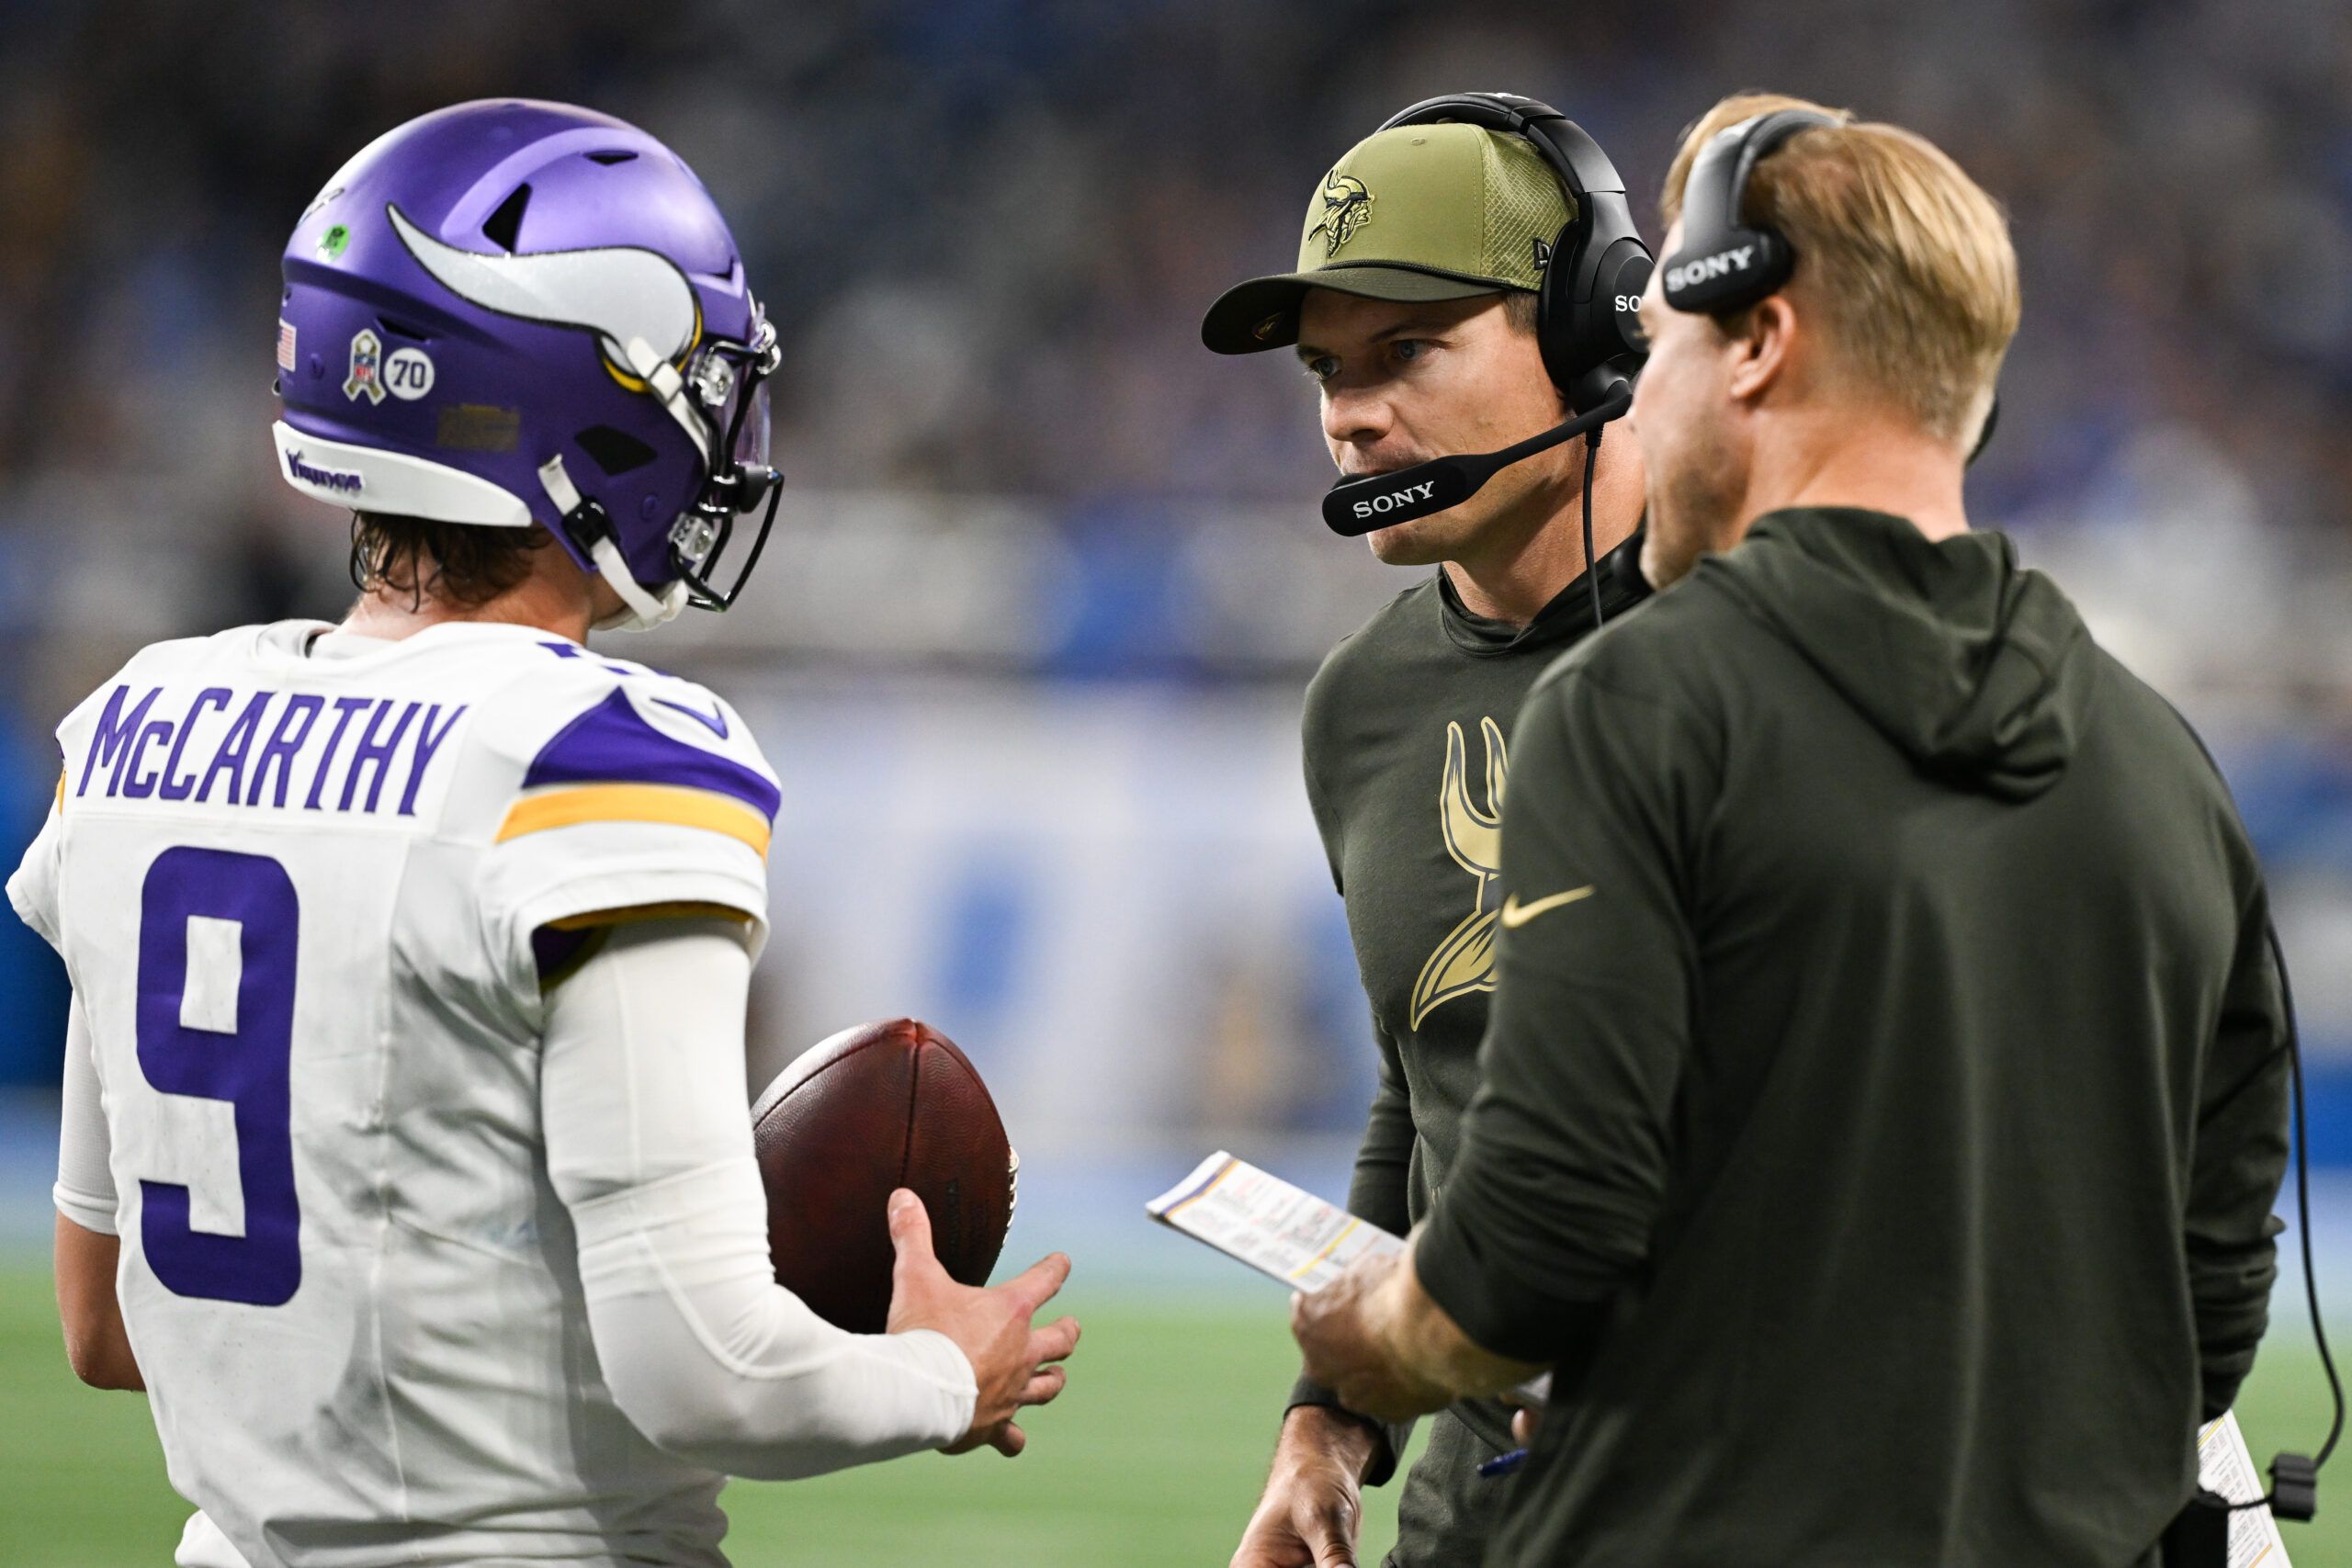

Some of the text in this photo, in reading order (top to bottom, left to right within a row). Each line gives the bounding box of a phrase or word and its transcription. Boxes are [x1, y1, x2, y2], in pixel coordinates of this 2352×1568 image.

[1665, 244, 1753, 293] SONY
[1614, 294, 1642, 312] SO
[393, 358, 426, 389] 70
[1352, 480, 1435, 519] SONY
[75, 684, 469, 817] McCARTHY
[136, 845, 302, 1306] 9
